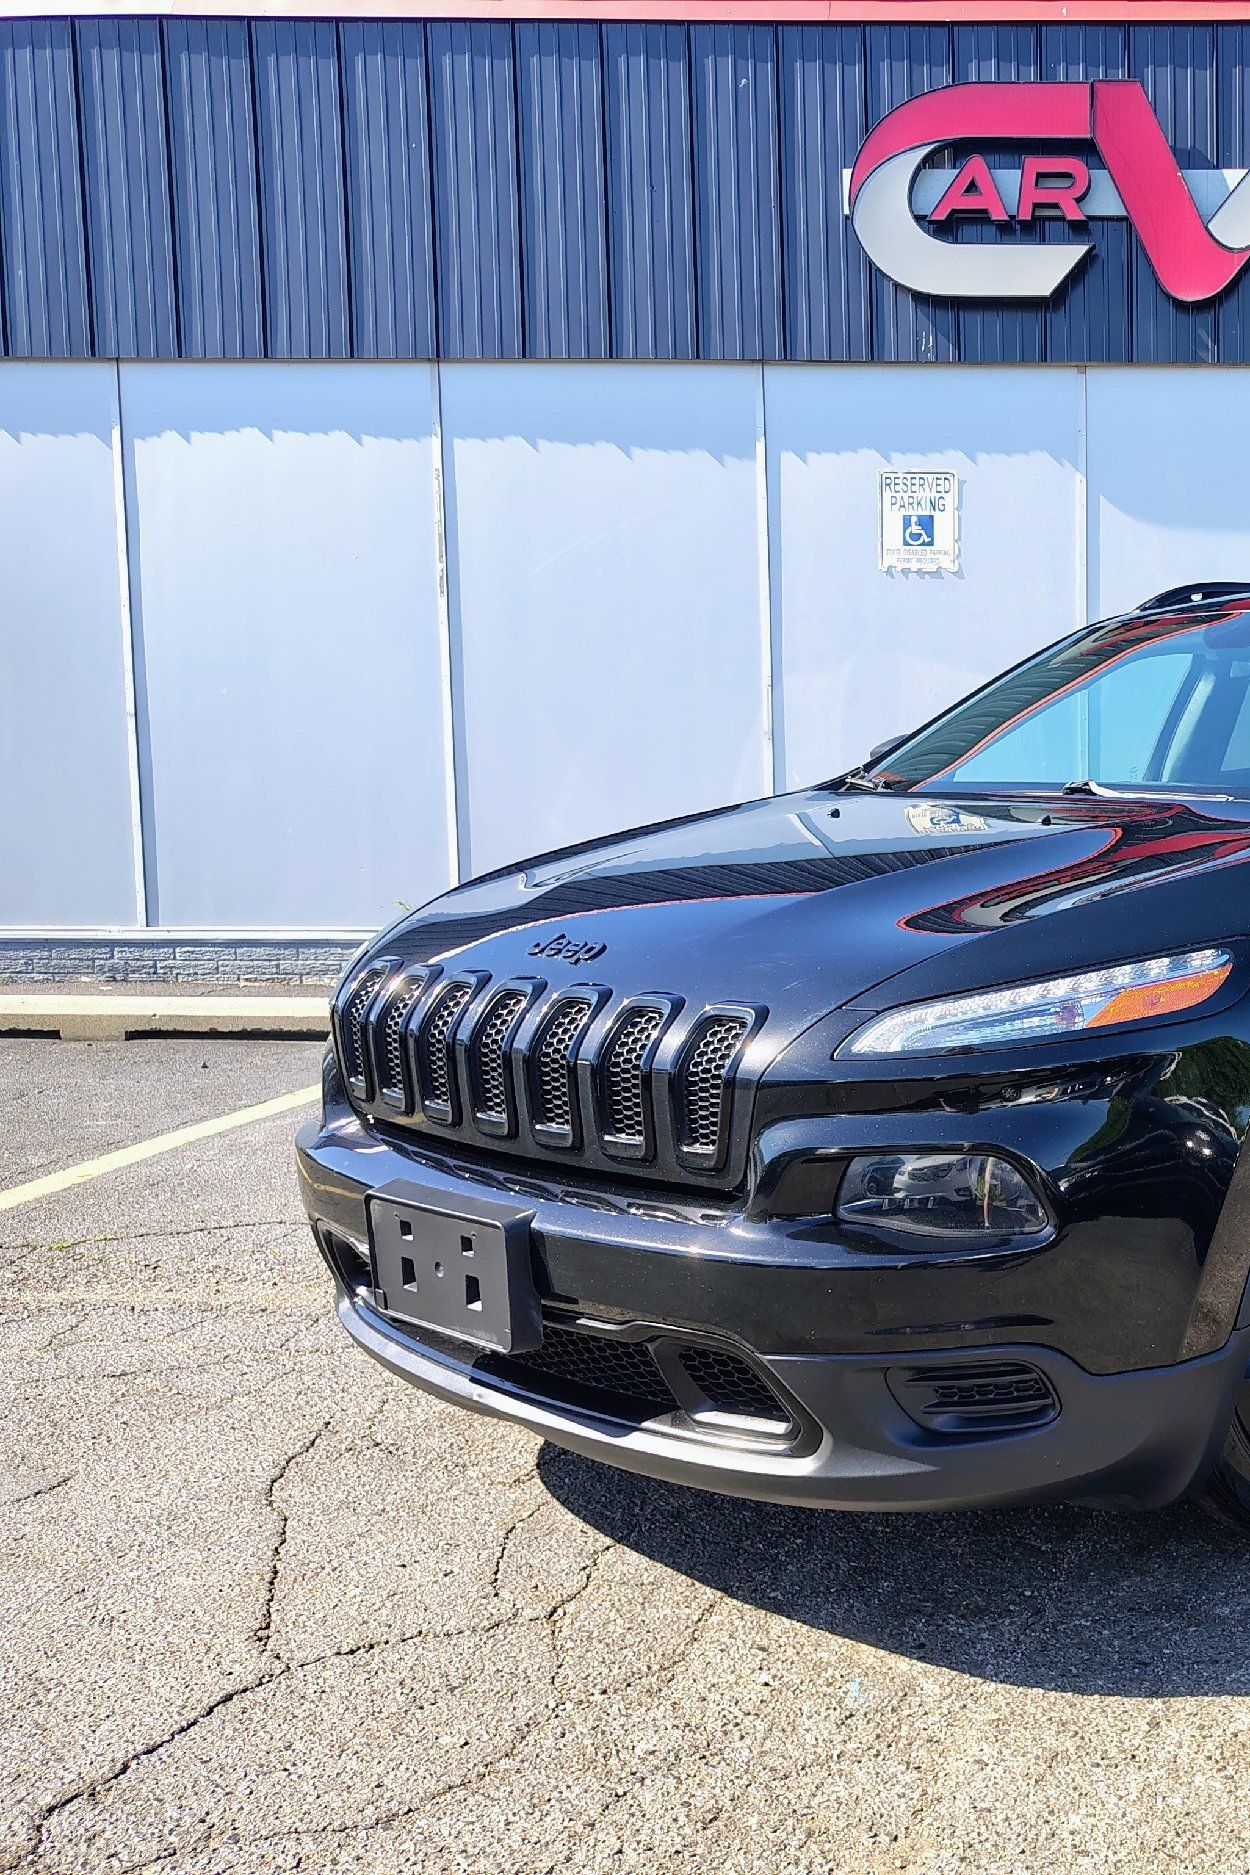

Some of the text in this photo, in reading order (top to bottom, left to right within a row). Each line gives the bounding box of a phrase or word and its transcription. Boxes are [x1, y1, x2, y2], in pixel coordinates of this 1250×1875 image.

[884, 476, 952, 493] RESERVED
[890, 495, 946, 512] PARKING
[527, 933, 607, 965] Jeep
